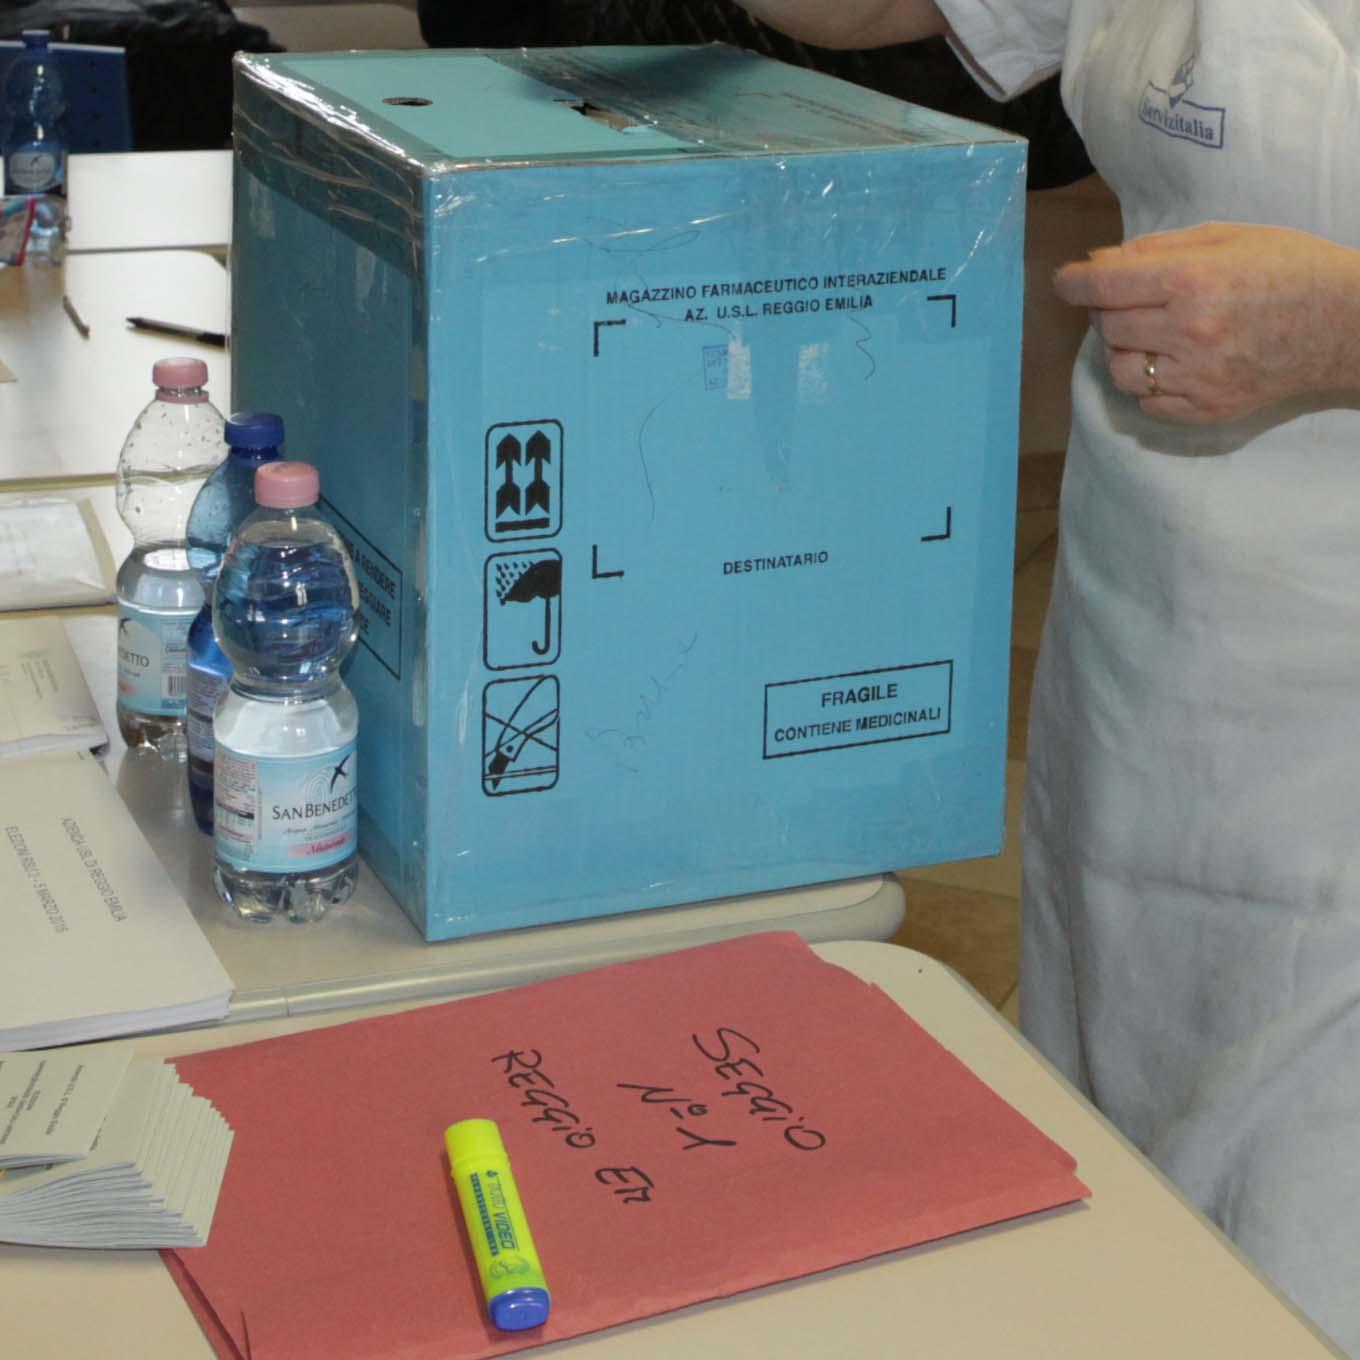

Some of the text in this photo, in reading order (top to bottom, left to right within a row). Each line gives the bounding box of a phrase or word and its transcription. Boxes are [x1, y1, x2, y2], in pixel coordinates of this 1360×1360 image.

[606, 267, 948, 305] MAGAZZINO FARMACEUTICO INTERAZIENDALE
[684, 295, 873, 322] AZ. U.S.L. REGGIO EMILIA
[722, 550, 829, 576] DESTINATARIO
[821, 683, 898, 708] FRAGILE
[774, 707, 942, 743] CONTIENE MEDICINALI
[36, 887, 60, 915] MARZO
[90, 868, 114, 897] REGGIO
[104, 896, 127, 922] EMILIA
[491, 1048, 597, 1149] REGGIO
[691, 1026, 827, 1151] SEGGIO
